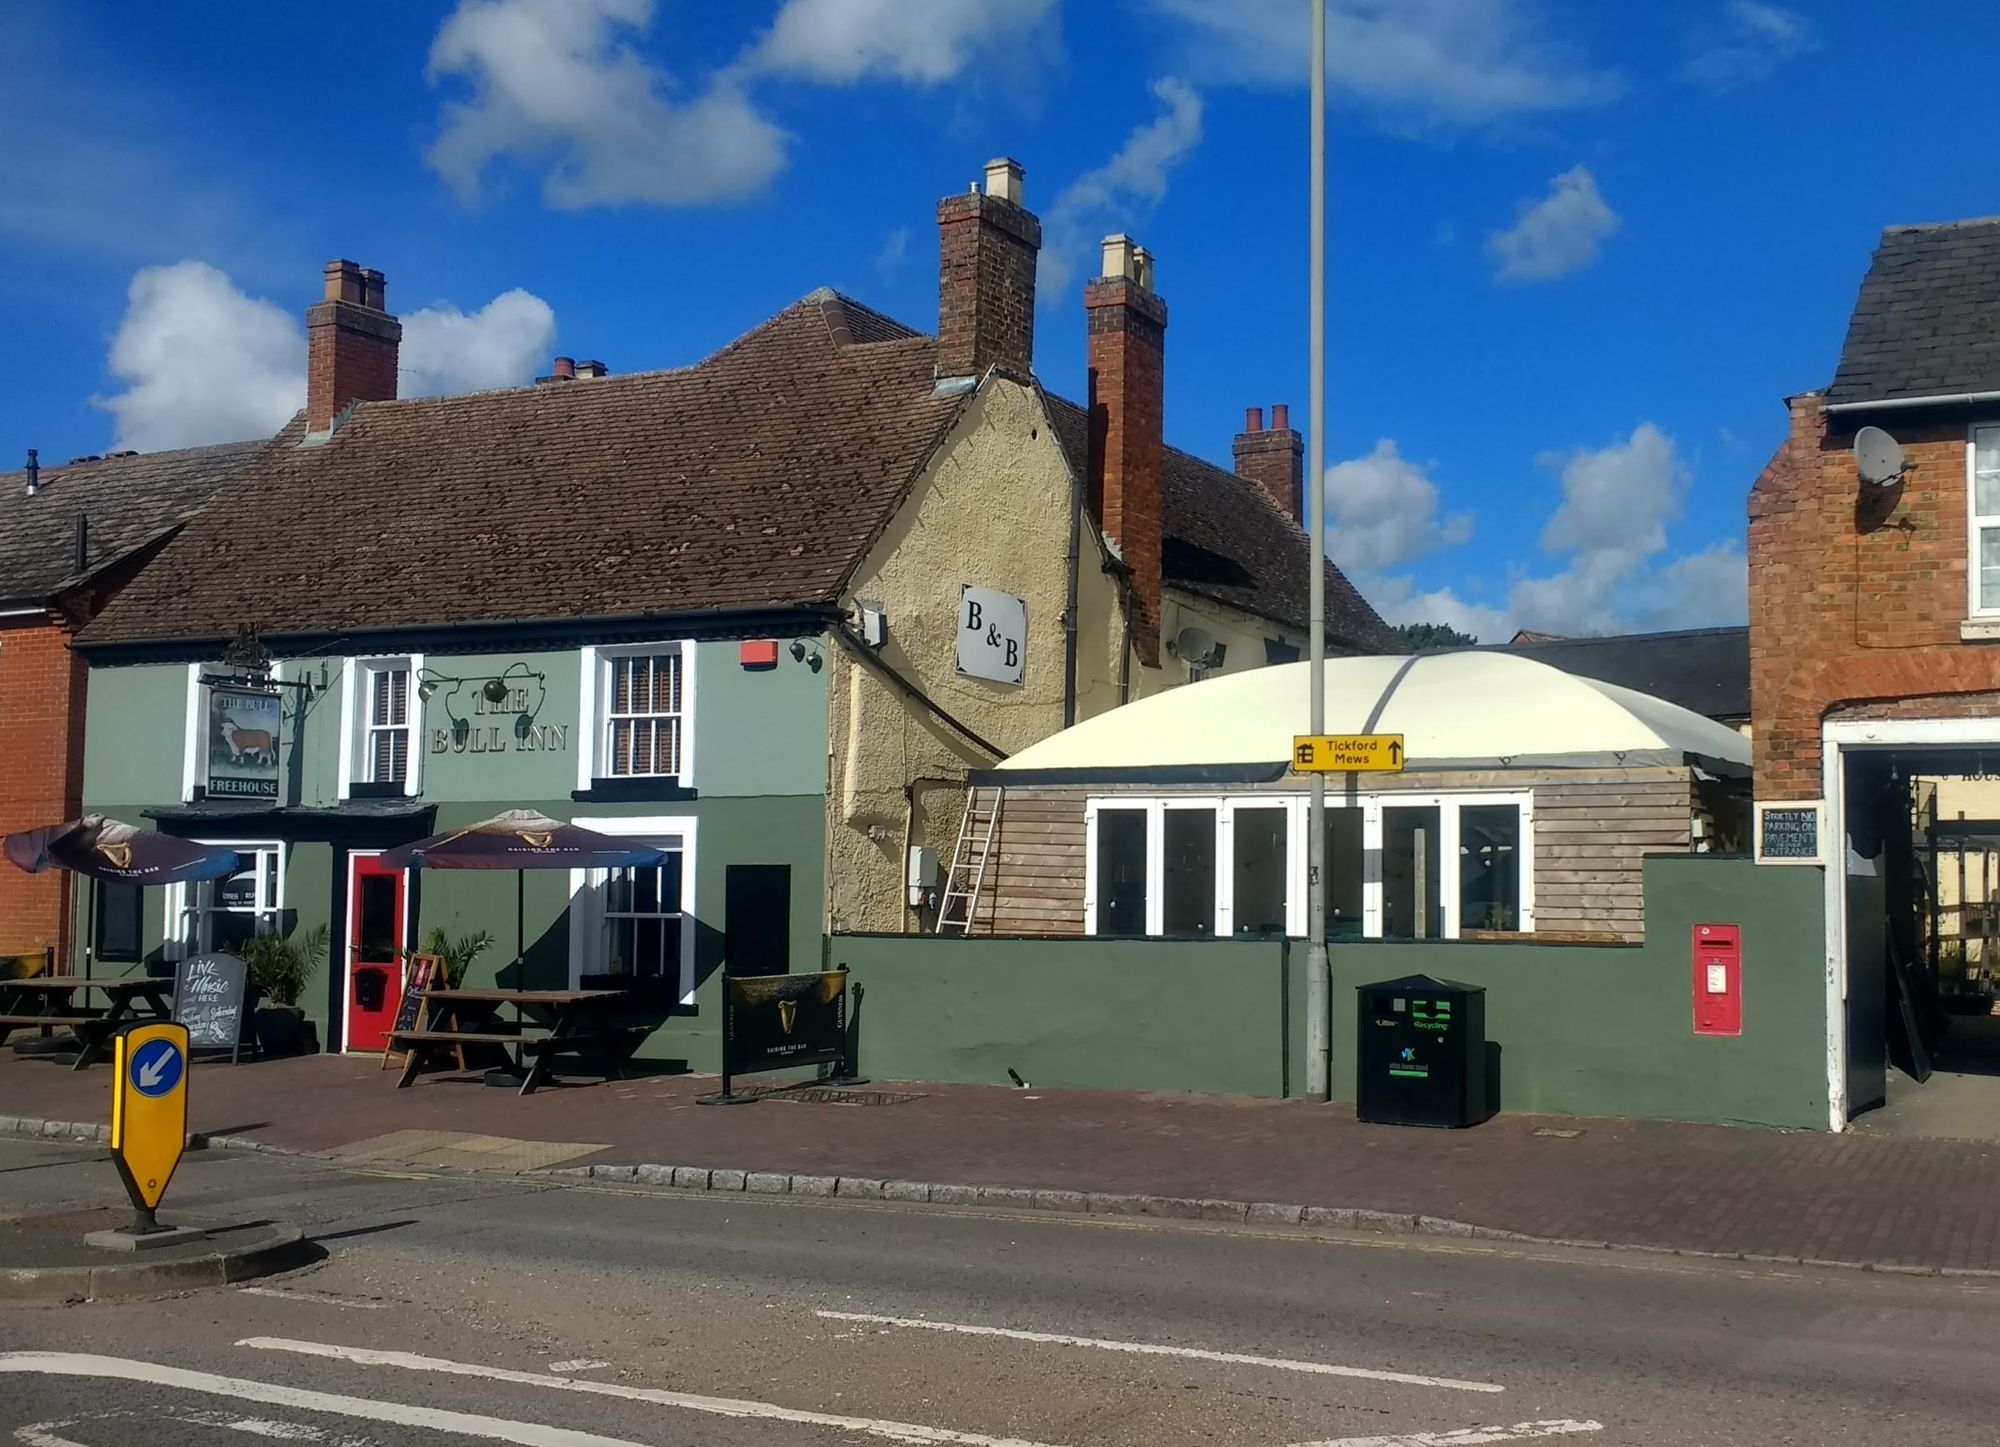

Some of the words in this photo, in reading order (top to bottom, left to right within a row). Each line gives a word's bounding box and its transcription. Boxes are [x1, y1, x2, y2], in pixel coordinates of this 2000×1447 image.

[222, 697, 240, 709] THE
[246, 699, 270, 712] BULL
[472, 687, 529, 715] THE
[431, 727, 506, 754] BULL
[516, 725, 568, 752] INN
[1327, 740, 1377, 751] Tickford
[1335, 754, 1370, 764] Mews
[210, 780, 277, 794] FREEHOUSE
[1764, 811, 1799, 820] STRICTLY
[1801, 812, 1815, 821] NO
[1764, 822, 1800, 832] PARKING
[1801, 822, 1816, 832] ON
[1764, 833, 1815, 843] PAVEMENT
[1764, 847, 1816, 856] ENTRANCE
[1415, 1021, 1447, 1031] Recycling
